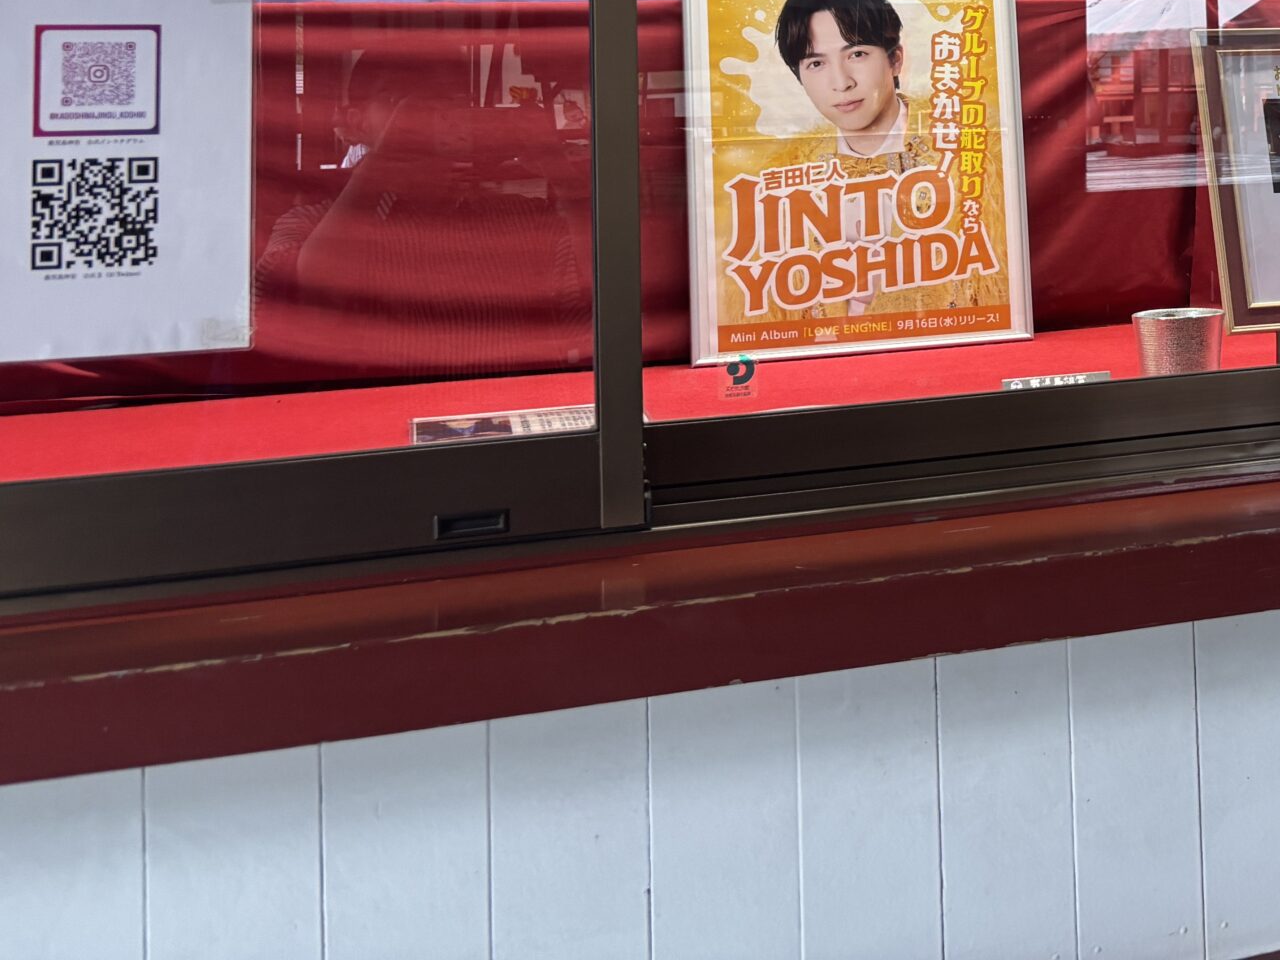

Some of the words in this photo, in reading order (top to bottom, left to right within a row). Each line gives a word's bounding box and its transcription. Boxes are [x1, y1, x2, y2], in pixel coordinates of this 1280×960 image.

[932, 33, 961, 178] おまかせ!
[726, 168, 952, 262] JINTO
[762, 161, 847, 191] 吉田仁人
[730, 233, 997, 313] YOSHIDA
[730, 332, 756, 343] Mini
[760, 329, 799, 341] Album
